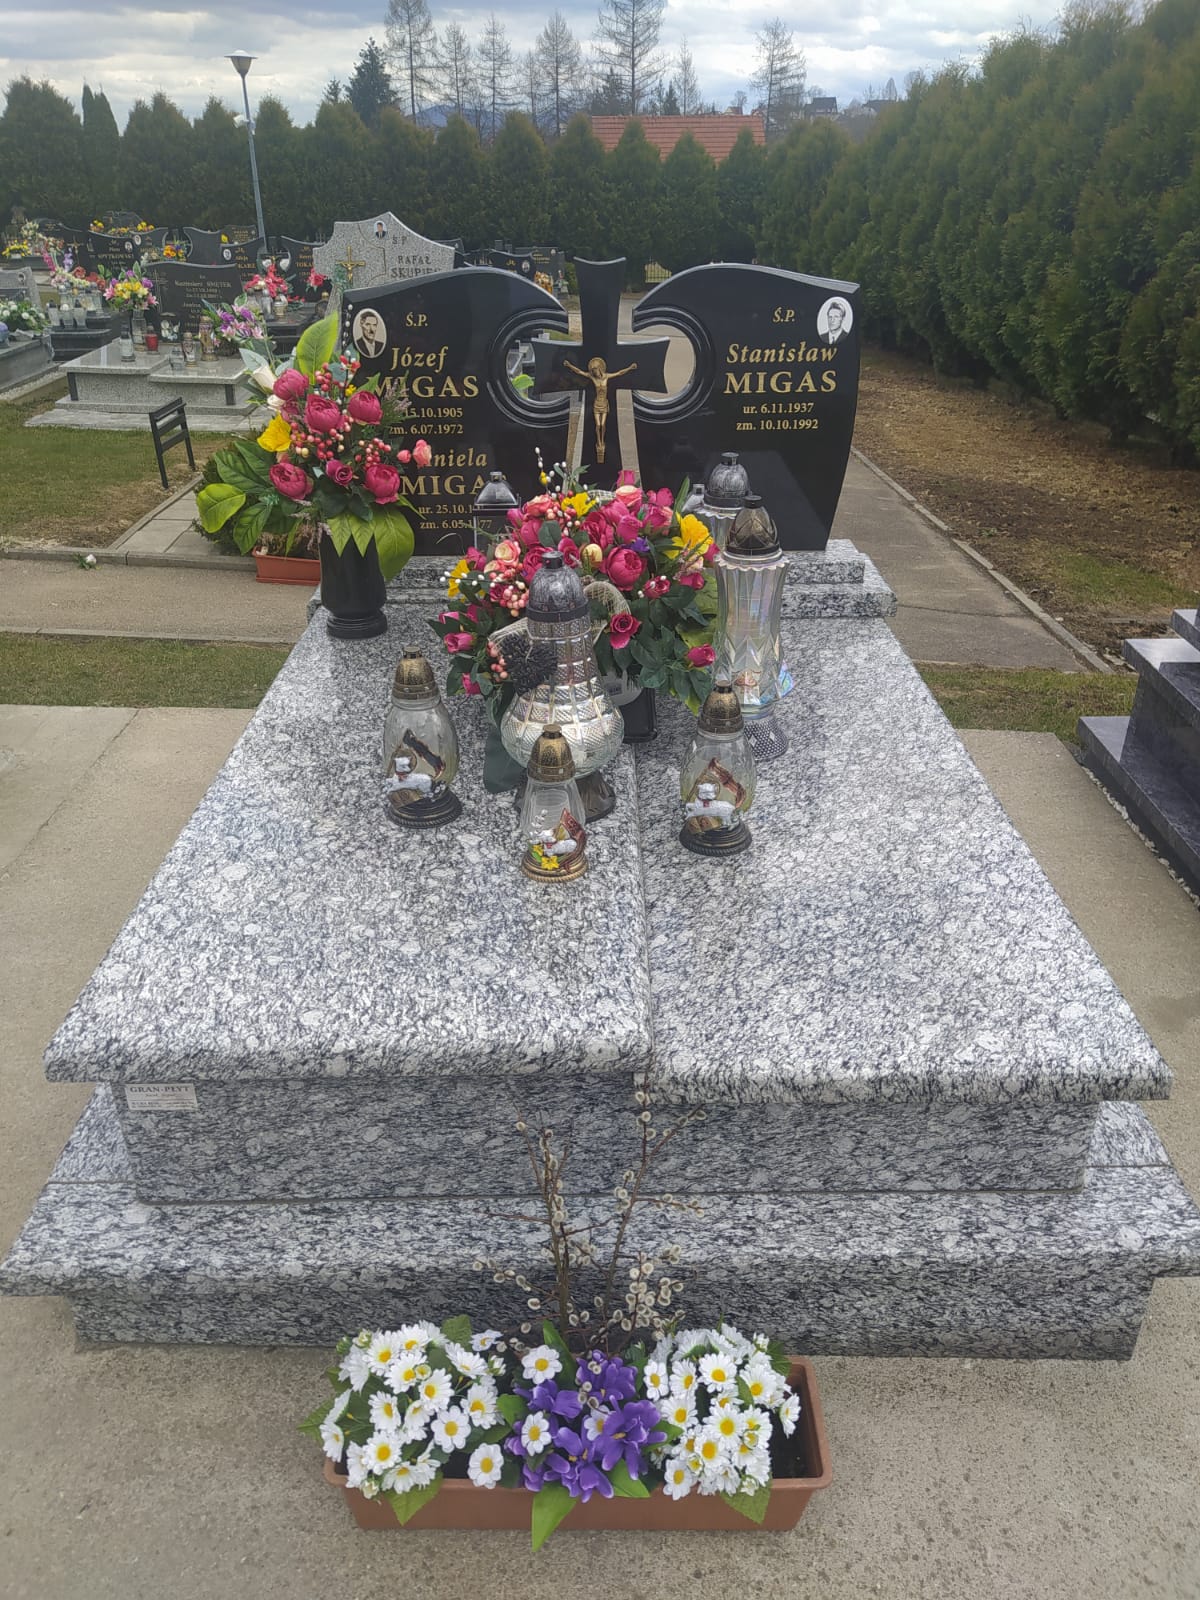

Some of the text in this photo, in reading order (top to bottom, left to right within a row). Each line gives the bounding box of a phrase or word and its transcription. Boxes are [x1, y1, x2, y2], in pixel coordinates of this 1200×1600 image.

[390, 267, 442, 278] SKUPIE
[405, 311, 429, 327] Ś.P.
[772, 306, 796, 323] Ś.P.
[390, 345, 448, 373] Józef
[726, 341, 838, 364] Stanisław
[723, 370, 837, 394] MIGAS
[743, 402, 814, 414] ur. 6.11.1937
[410, 424, 464, 434] 6.07.1972
[736, 419, 818, 431] zm. 10.10.1992
[425, 447, 488, 467] niela
[400, 474, 507, 496] MIGA
[418, 504, 484, 514] ur. 25.10.1
[420, 519, 493, 529] zm. 6.05.177
